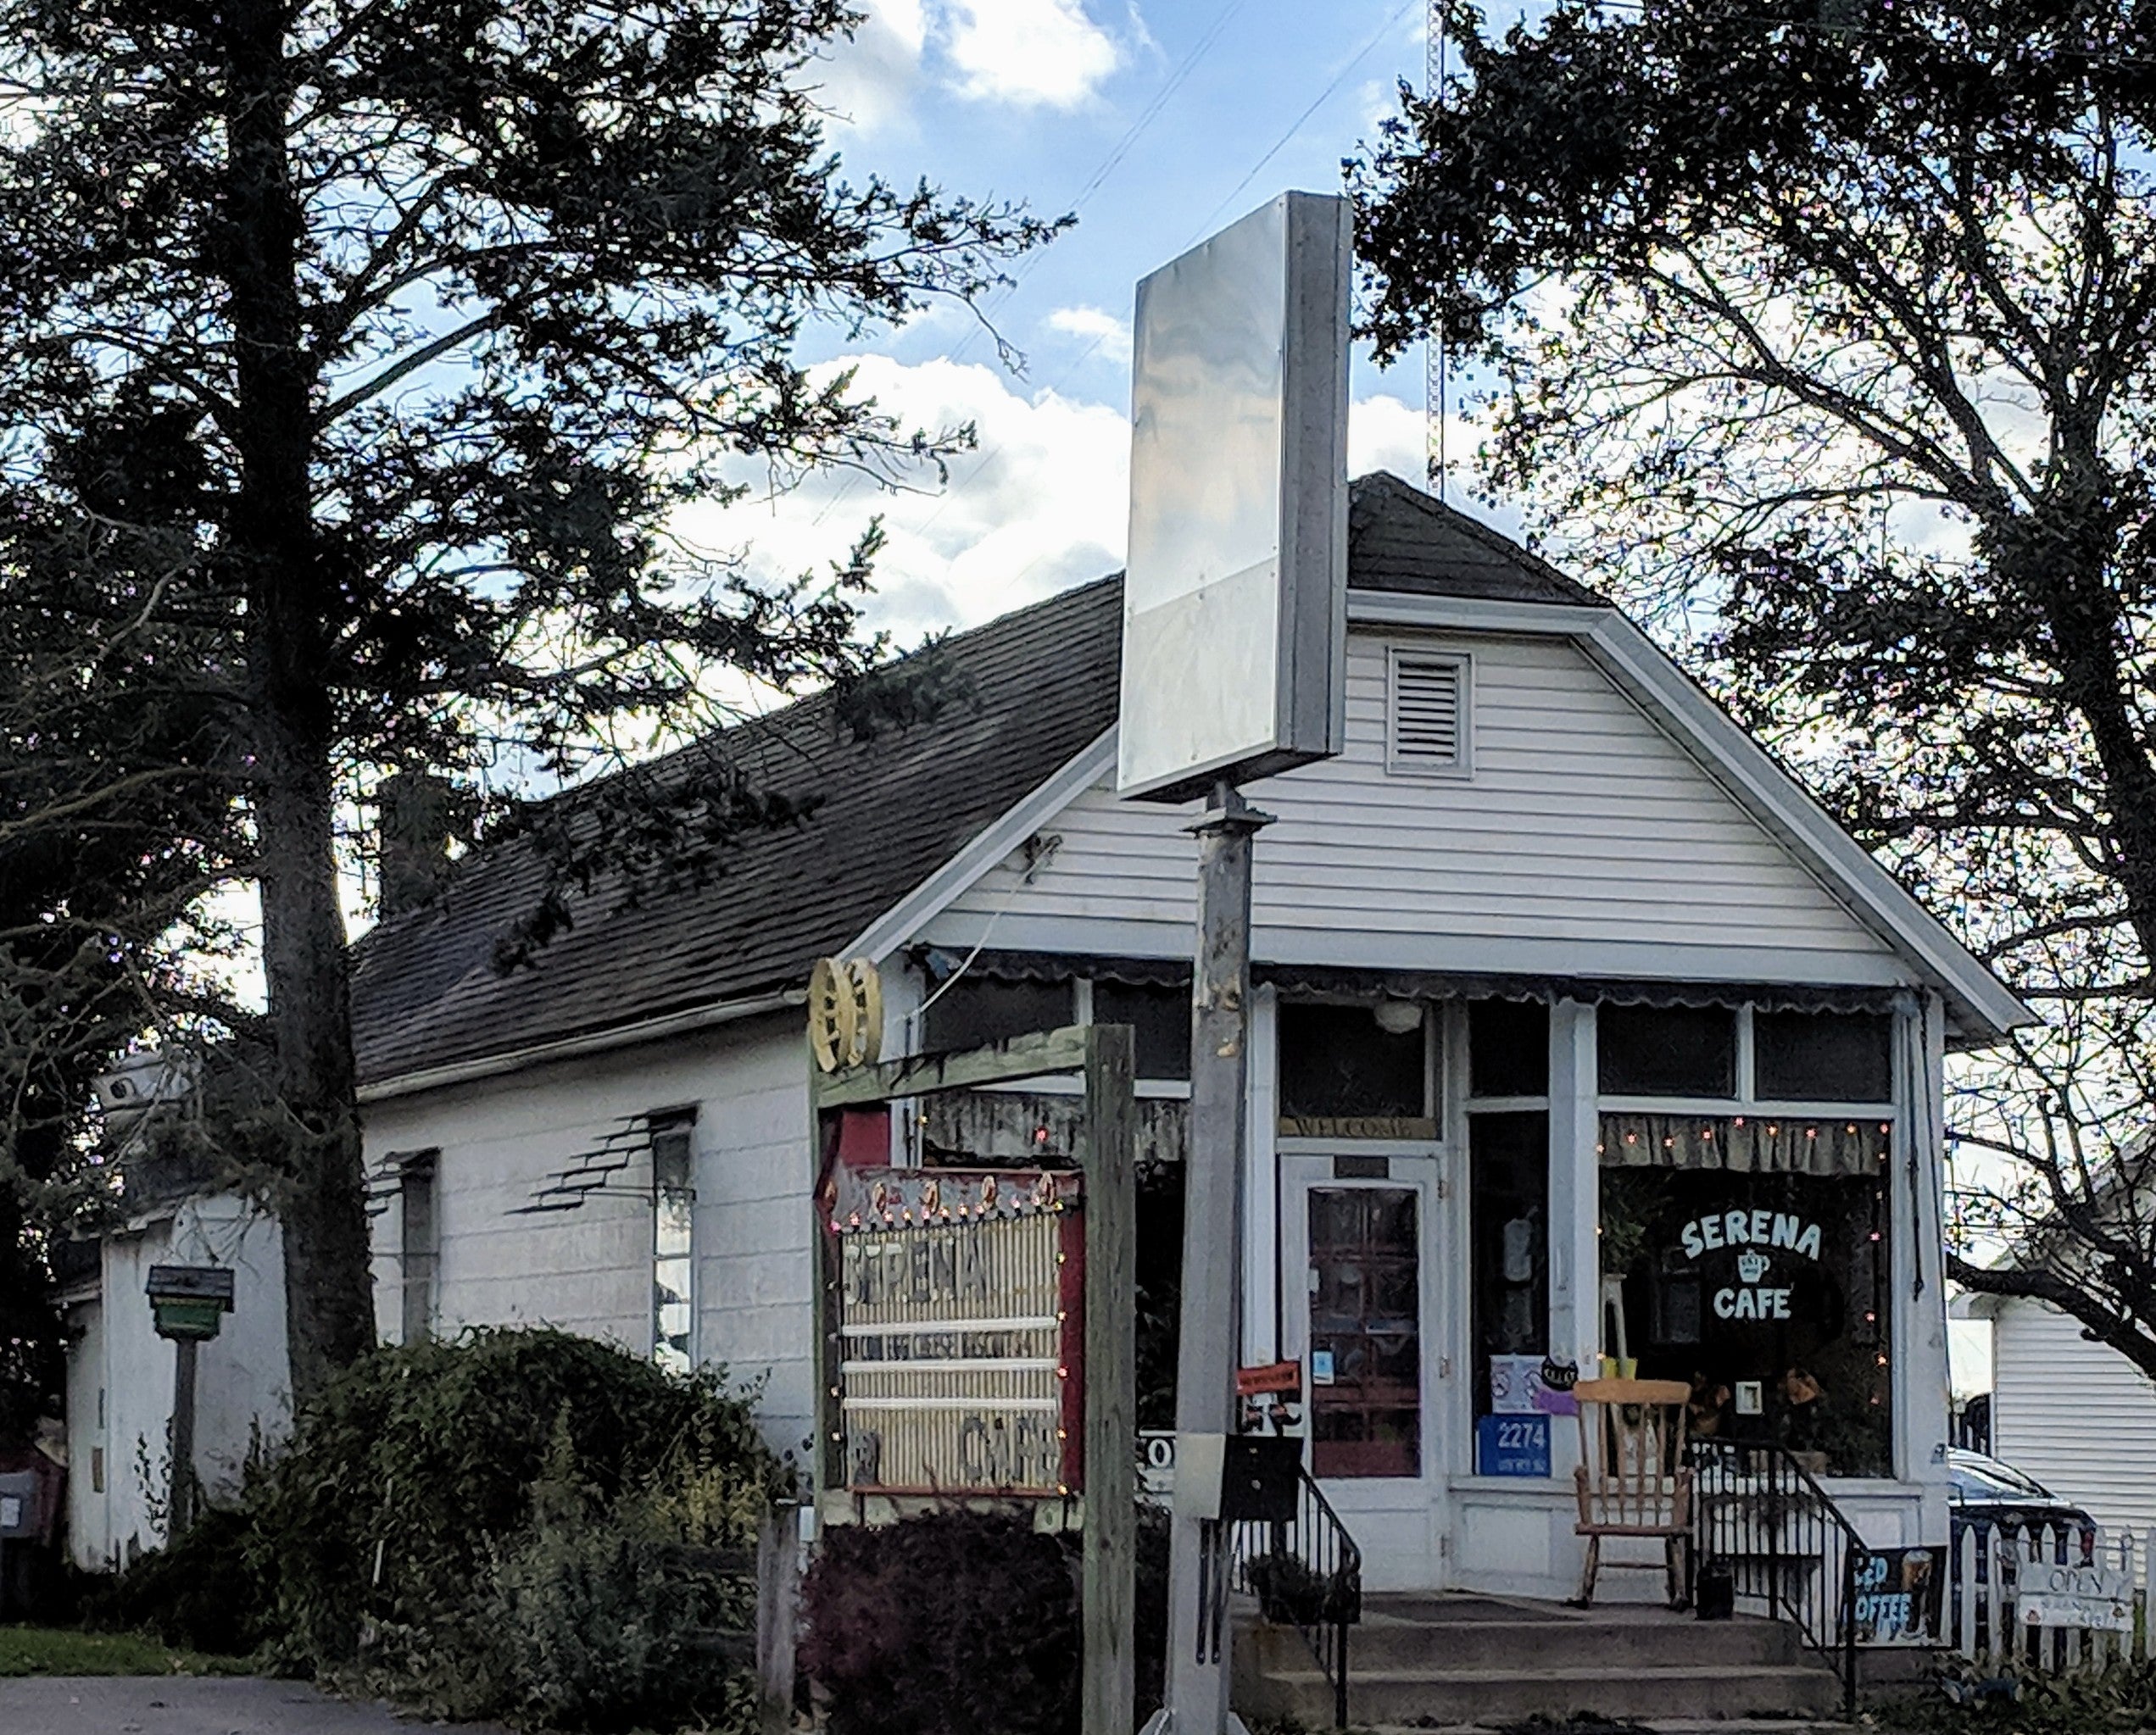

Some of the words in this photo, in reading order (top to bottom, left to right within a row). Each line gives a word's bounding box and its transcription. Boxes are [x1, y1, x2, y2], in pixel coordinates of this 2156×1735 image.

[1681, 1209, 1821, 1261] SERENA
[1713, 1287, 1791, 1319] CAFE
[1497, 1421, 1545, 1449] 2274
[1844, 1593, 1911, 1623] OFFEE
